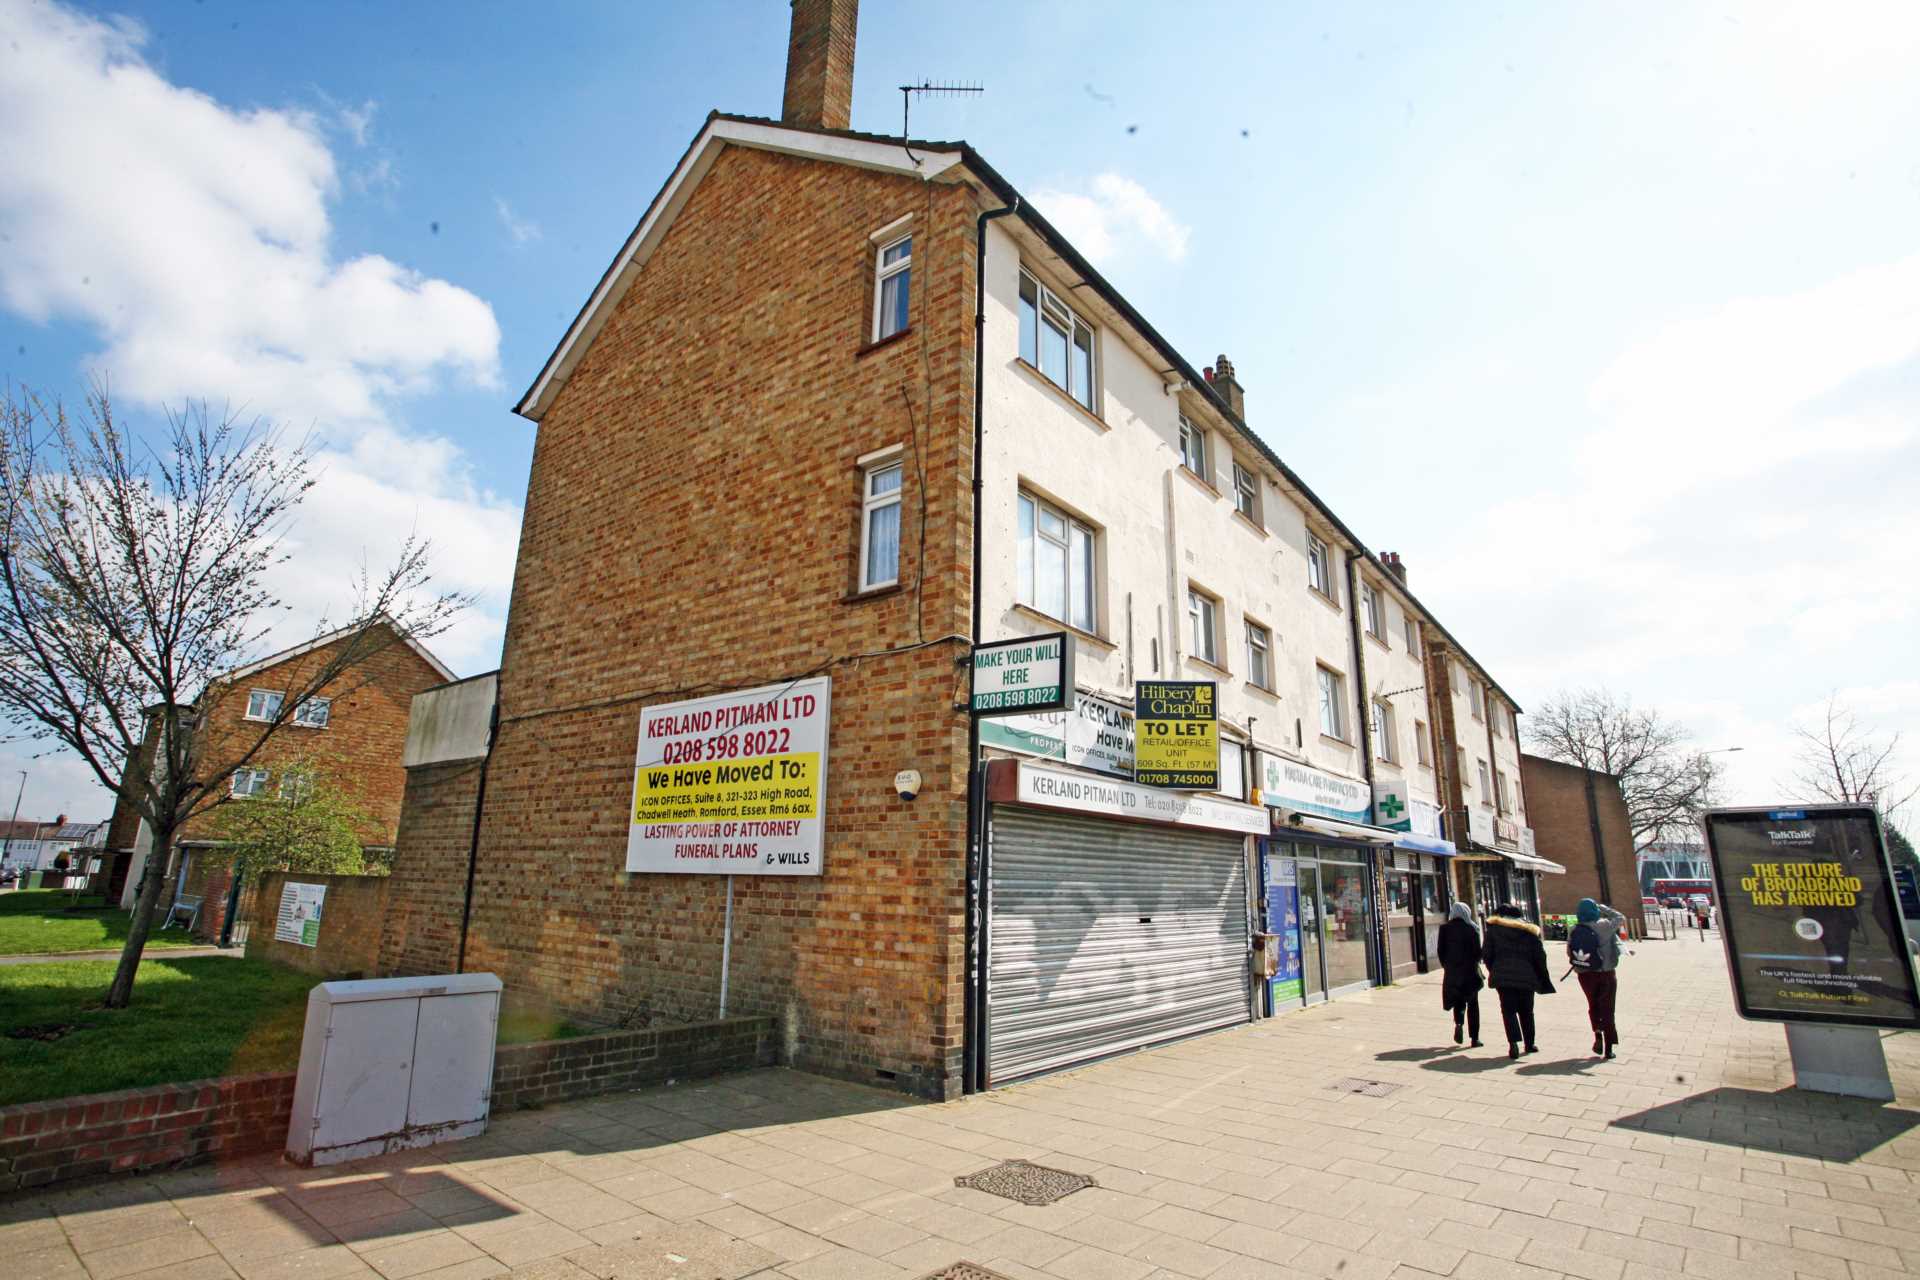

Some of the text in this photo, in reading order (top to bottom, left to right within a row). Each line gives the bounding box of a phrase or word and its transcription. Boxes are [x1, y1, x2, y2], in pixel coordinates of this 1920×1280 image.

[976, 644, 1060, 669] MAKE YOUR WILL
[1002, 668, 1029, 685] HERE
[976, 688, 1056, 709] 0208 598 8022
[1141, 685, 1194, 702] Hilbery
[648, 694, 816, 738] KERLAND PITMAN LTD
[1151, 700, 1211, 718] Chaplin
[1144, 723, 1208, 736] TO LET
[664, 728, 790, 765] 0208 598 8022
[1096, 730, 1123, 750] Have
[1142, 738, 1212, 747] RETAIL/OFFICE
[1166, 749, 1187, 757] UNIT
[648, 760, 805, 789] We Have Moved To:
[1139, 774, 1214, 784] 01708 745000
[642, 797, 659, 806] ICON
[660, 794, 693, 805] OFFICES,
[695, 792, 715, 804] Suite
[727, 790, 758, 801] 321-323
[761, 788, 781, 802] High
[784, 786, 812, 799] Road,
[1033, 776, 1136, 807] KERLAND PITMAN LTD
[637, 809, 671, 820] Chadwell
[700, 806, 739, 817] Romford,
[742, 806, 767, 816] Essex
[770, 804, 789, 814] Rm6
[645, 820, 800, 839] LASTING POWER OF ATTORNEY
[1768, 831, 1812, 839] TalkTalk
[675, 843, 758, 858] FUNERAL PLANS
[767, 852, 810, 864] & WILLS
[1752, 863, 1844, 877] THE FUTURE
[1742, 877, 1862, 892] OF BROADBAND
[1752, 891, 1856, 906] HAS ARRIVED
